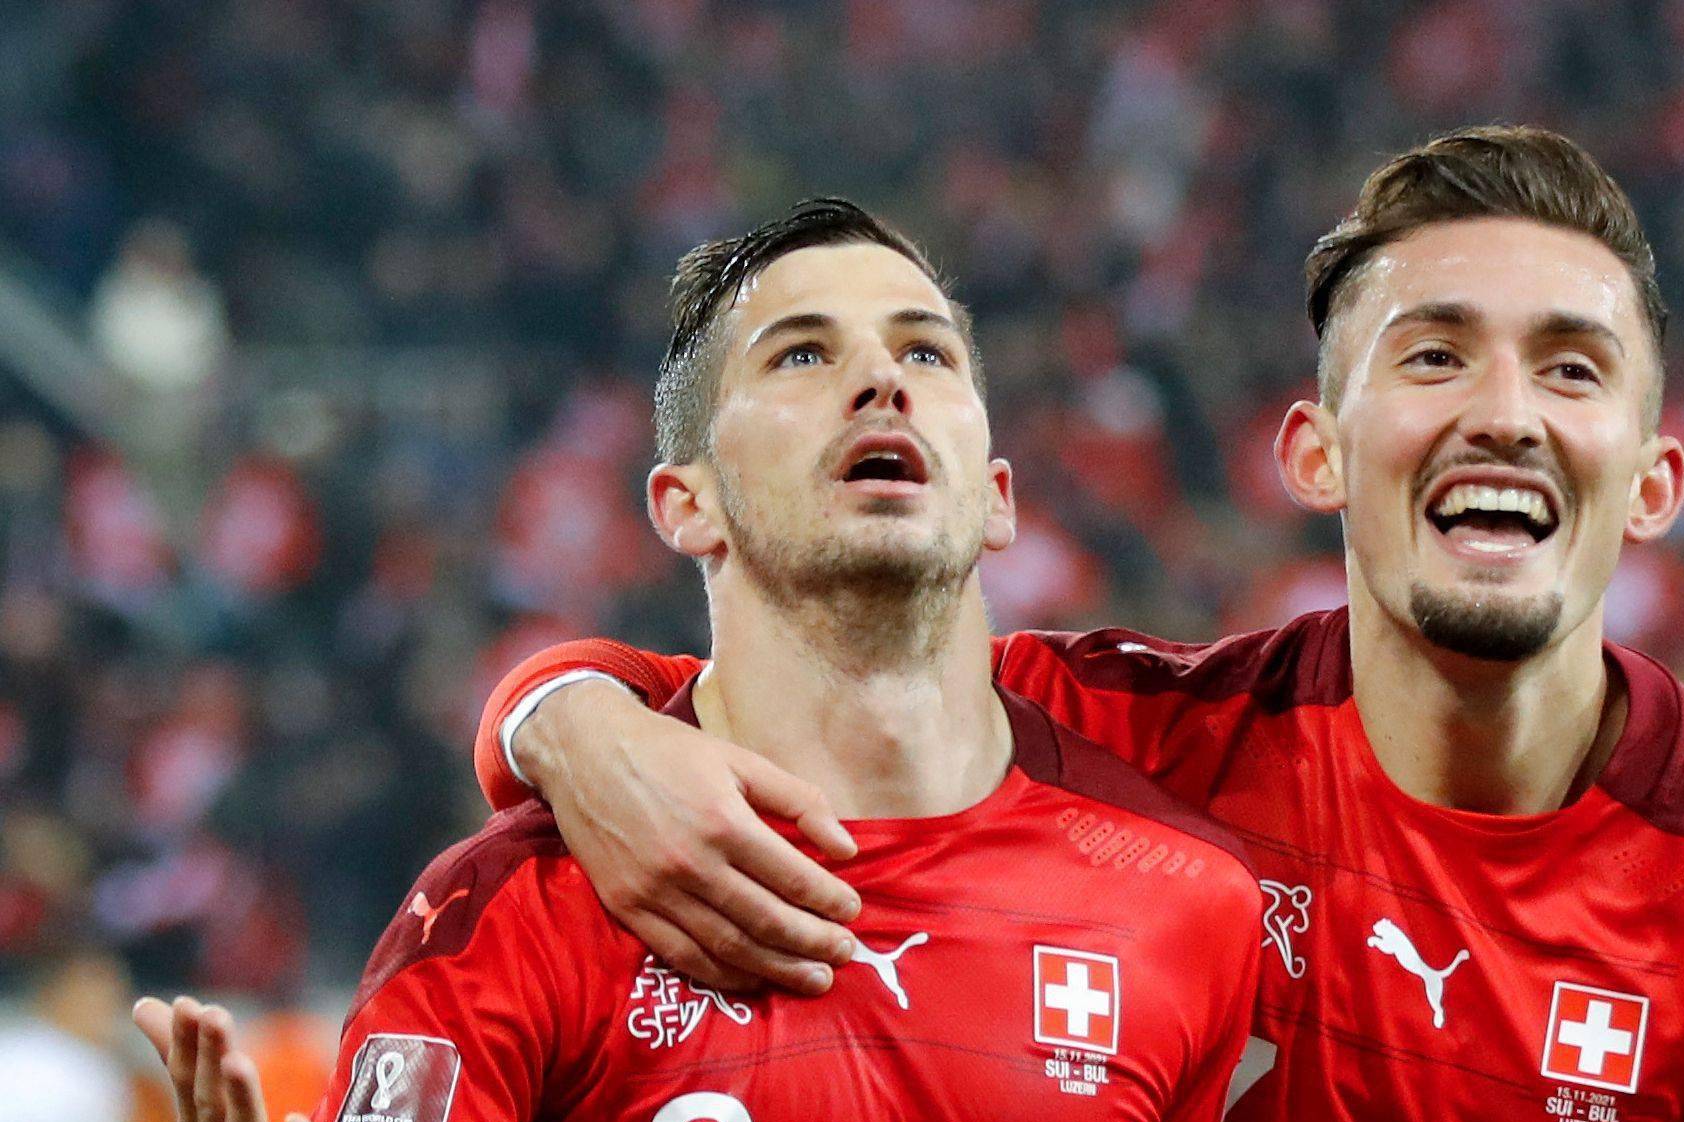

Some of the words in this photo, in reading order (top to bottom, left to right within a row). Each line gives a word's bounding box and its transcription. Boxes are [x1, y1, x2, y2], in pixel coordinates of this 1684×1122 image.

[1045, 1059, 1070, 1079] SUI
[1083, 1064, 1109, 1083] BUL
[1546, 1096, 1573, 1116] SUI
